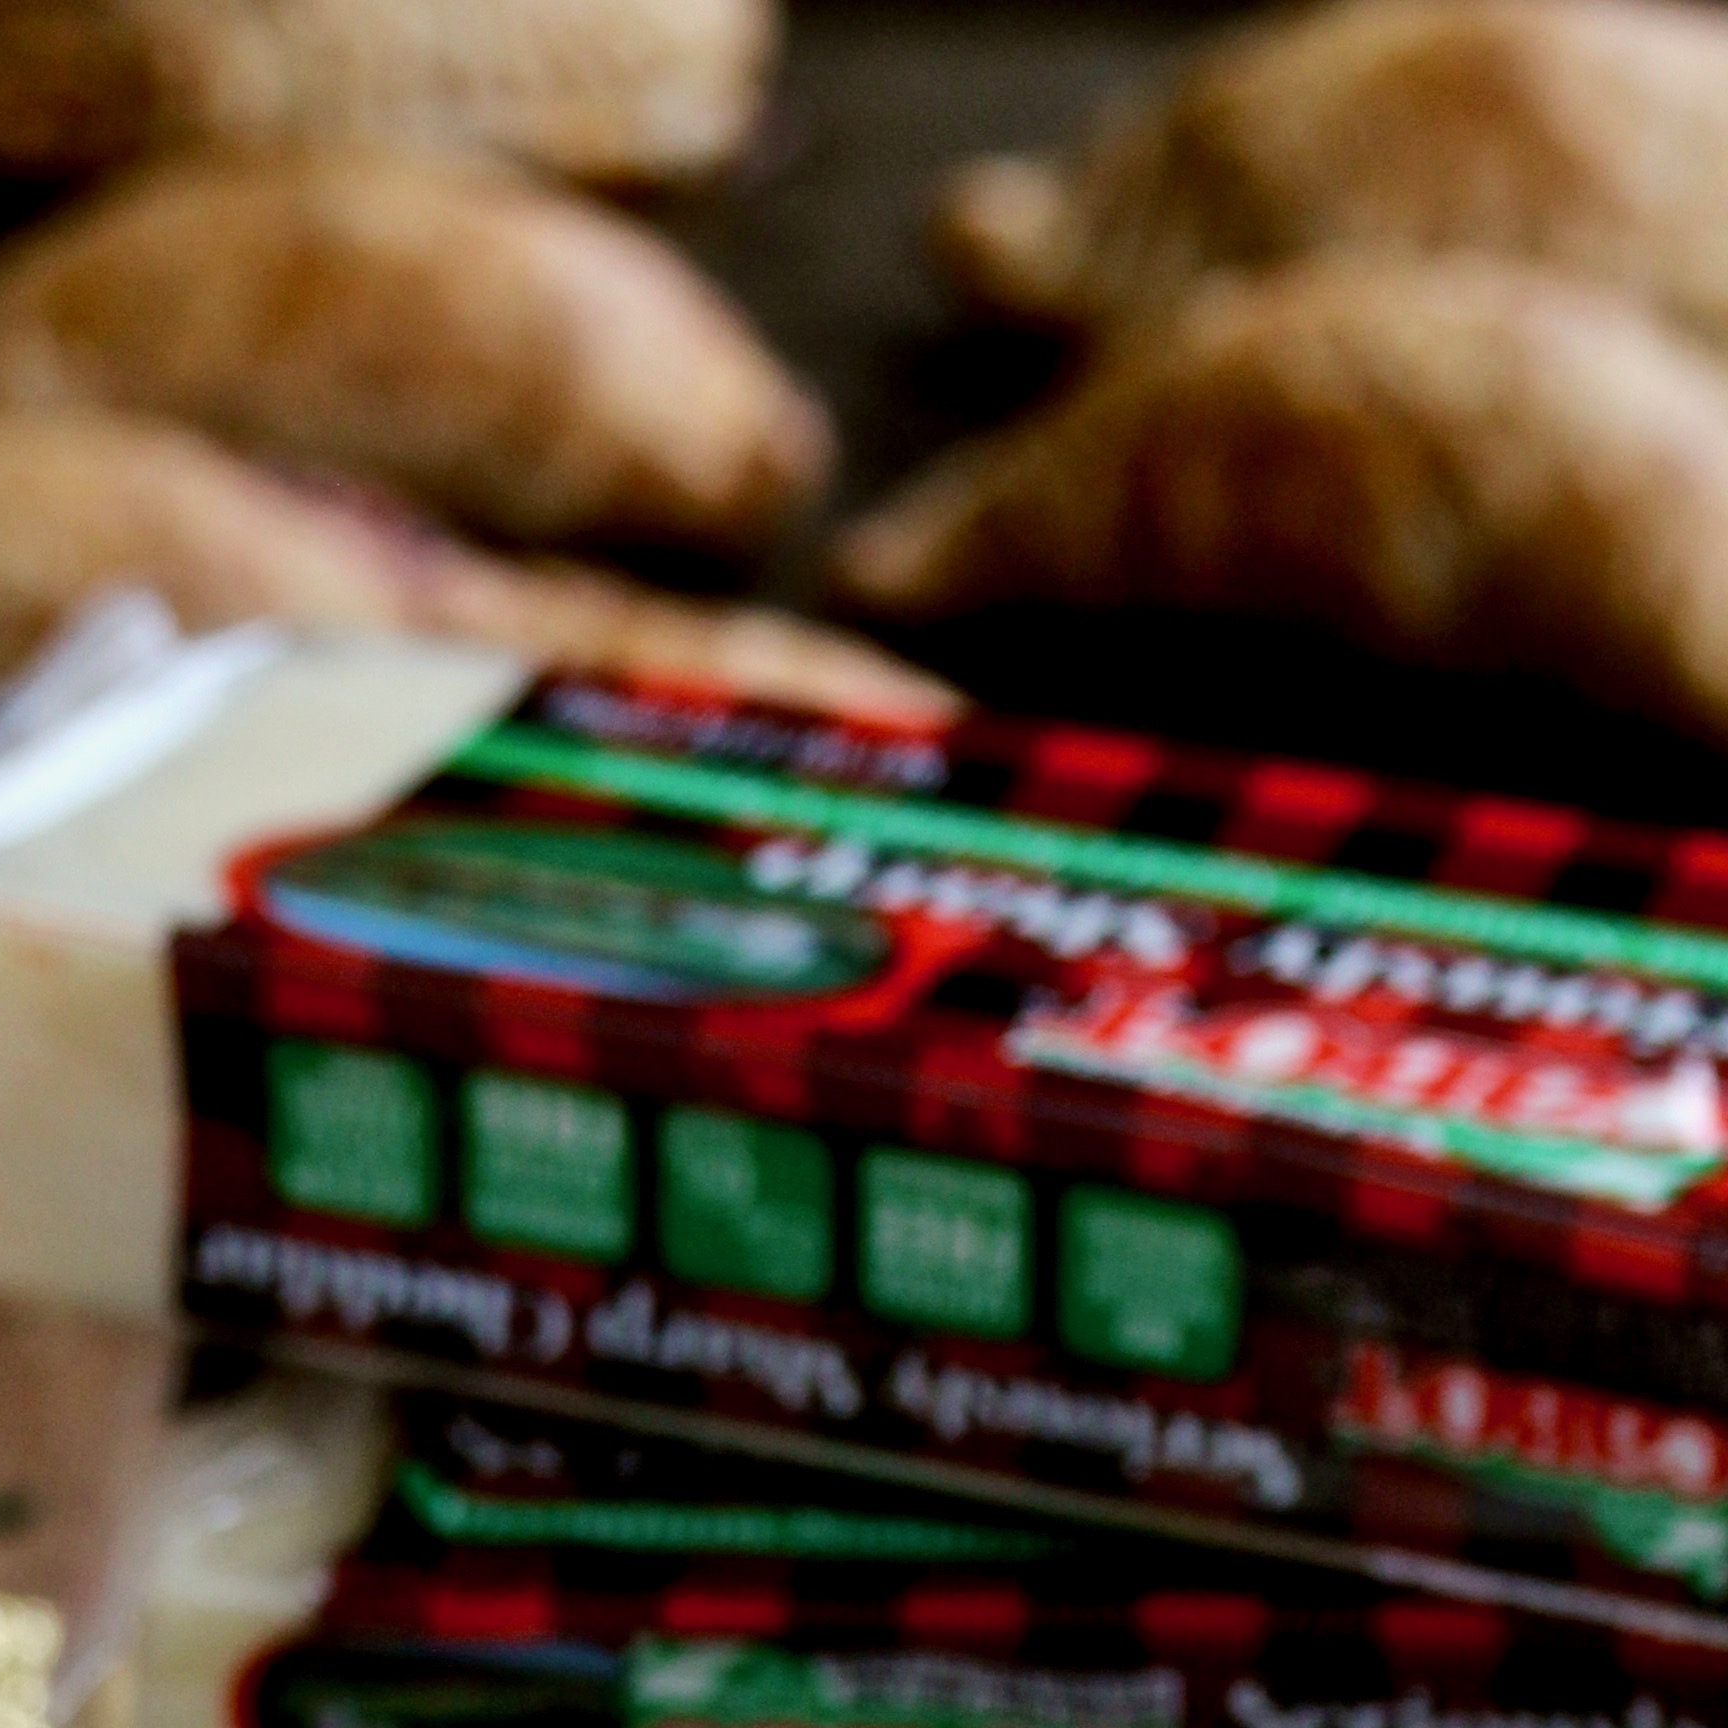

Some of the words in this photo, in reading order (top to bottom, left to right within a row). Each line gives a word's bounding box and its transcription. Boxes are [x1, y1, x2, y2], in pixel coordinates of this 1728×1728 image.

[198, 1225, 573, 1361] Cheddar
[584, 1281, 861, 1415] Sharp
[889, 1342, 1301, 1506] Seriously
